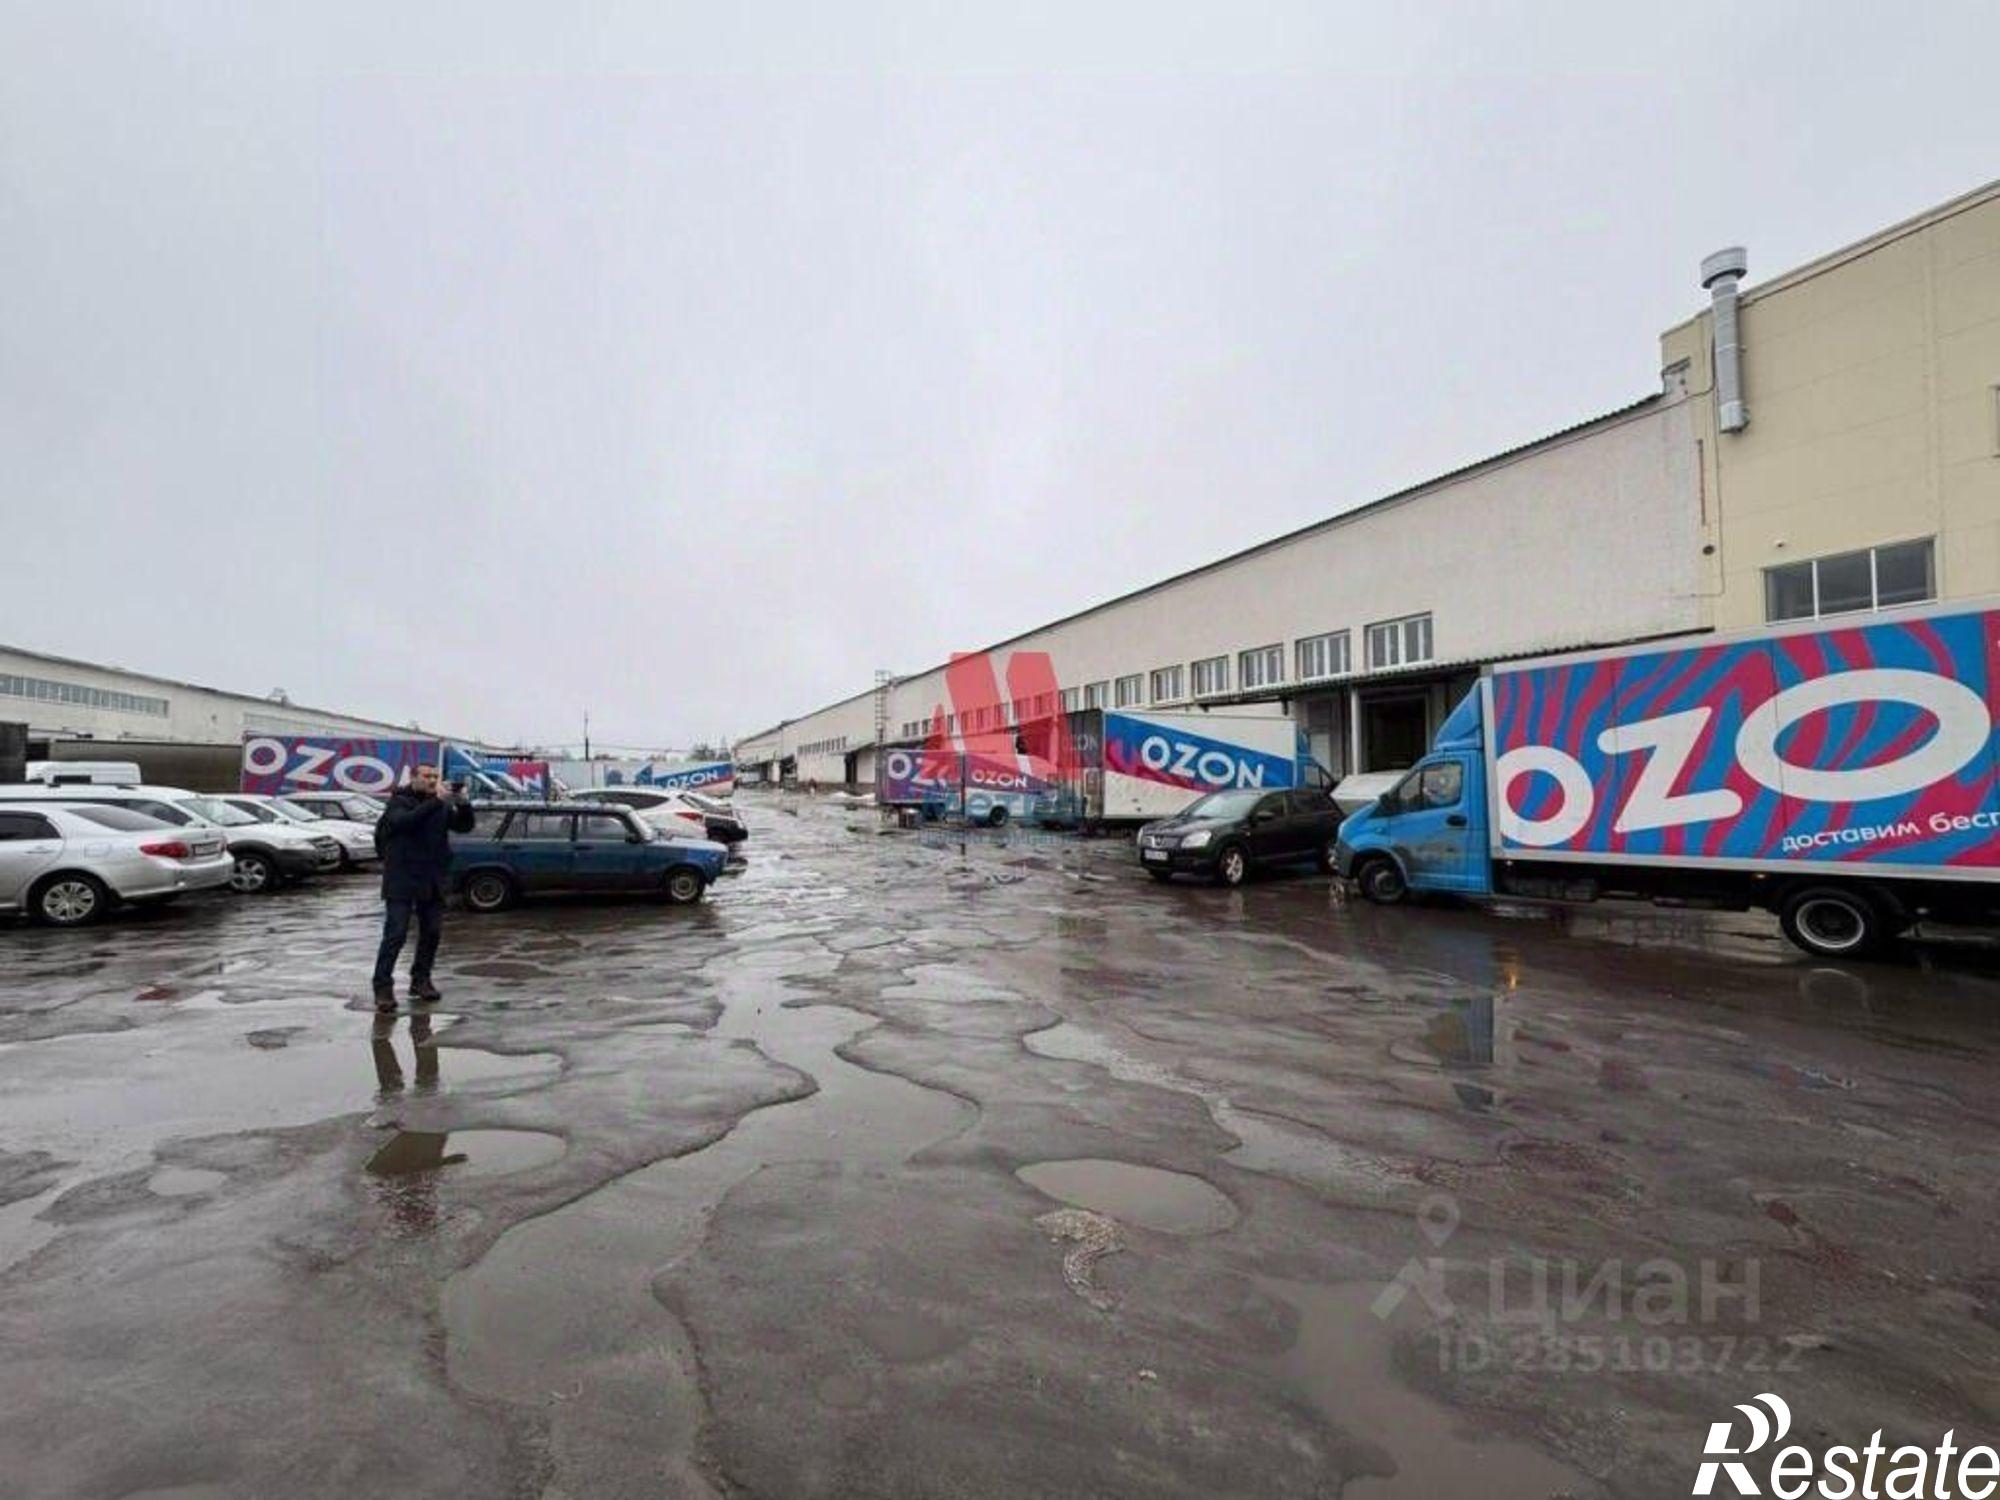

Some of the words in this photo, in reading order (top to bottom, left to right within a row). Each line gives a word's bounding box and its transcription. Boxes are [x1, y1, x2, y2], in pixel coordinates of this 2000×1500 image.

[1141, 736, 1264, 788] OZON
[667, 770, 719, 791] OZON
[971, 769, 1027, 788] OZON
[1782, 821, 1921, 852] доставим
